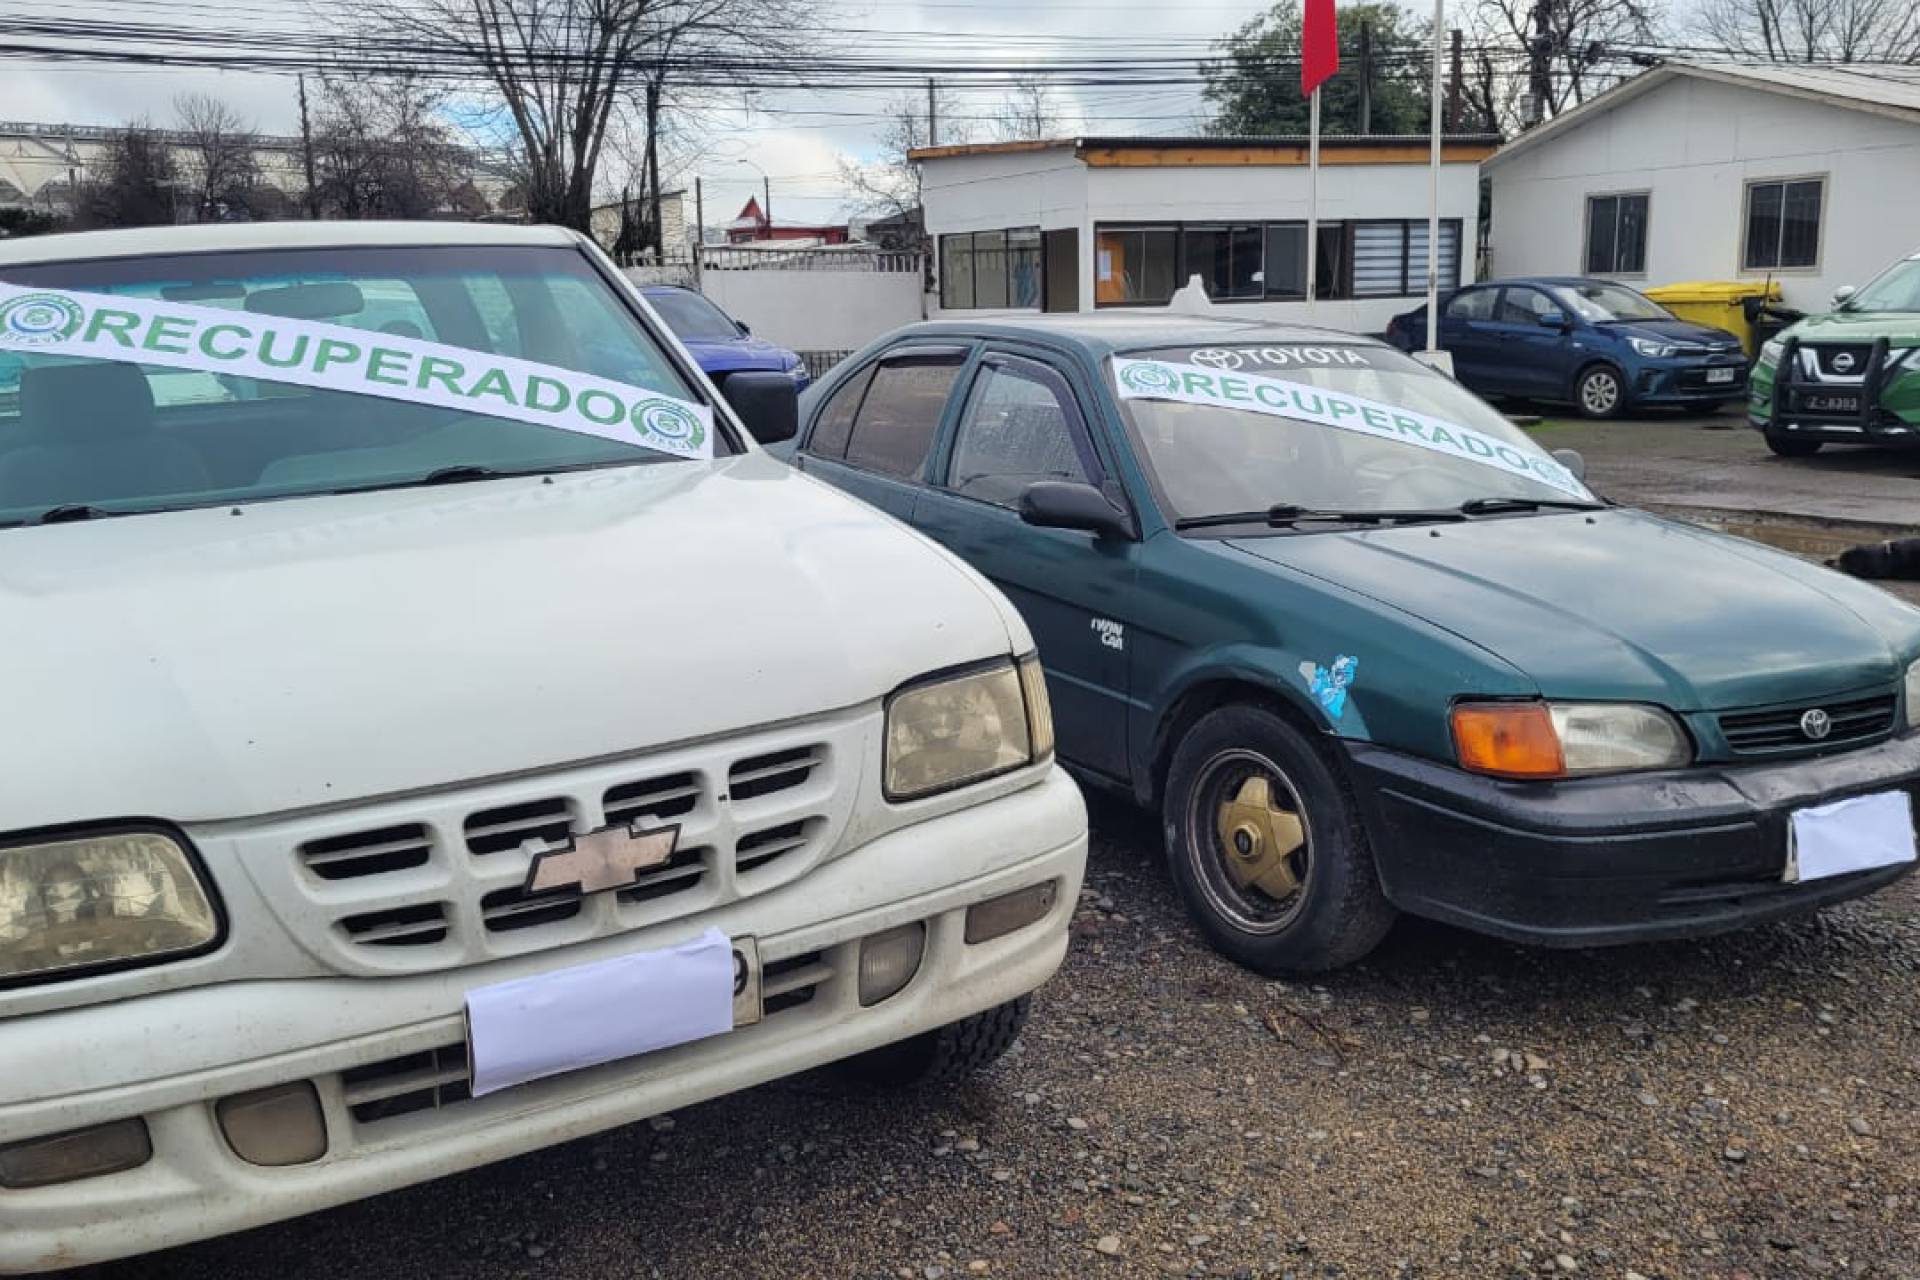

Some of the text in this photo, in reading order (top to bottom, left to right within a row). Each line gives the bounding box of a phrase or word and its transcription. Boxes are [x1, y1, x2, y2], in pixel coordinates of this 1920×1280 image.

[83, 308, 626, 426] RECUPERADO
[1239, 347, 1371, 365] TOYOTA
[1181, 372, 1530, 470] RECUPERADO
